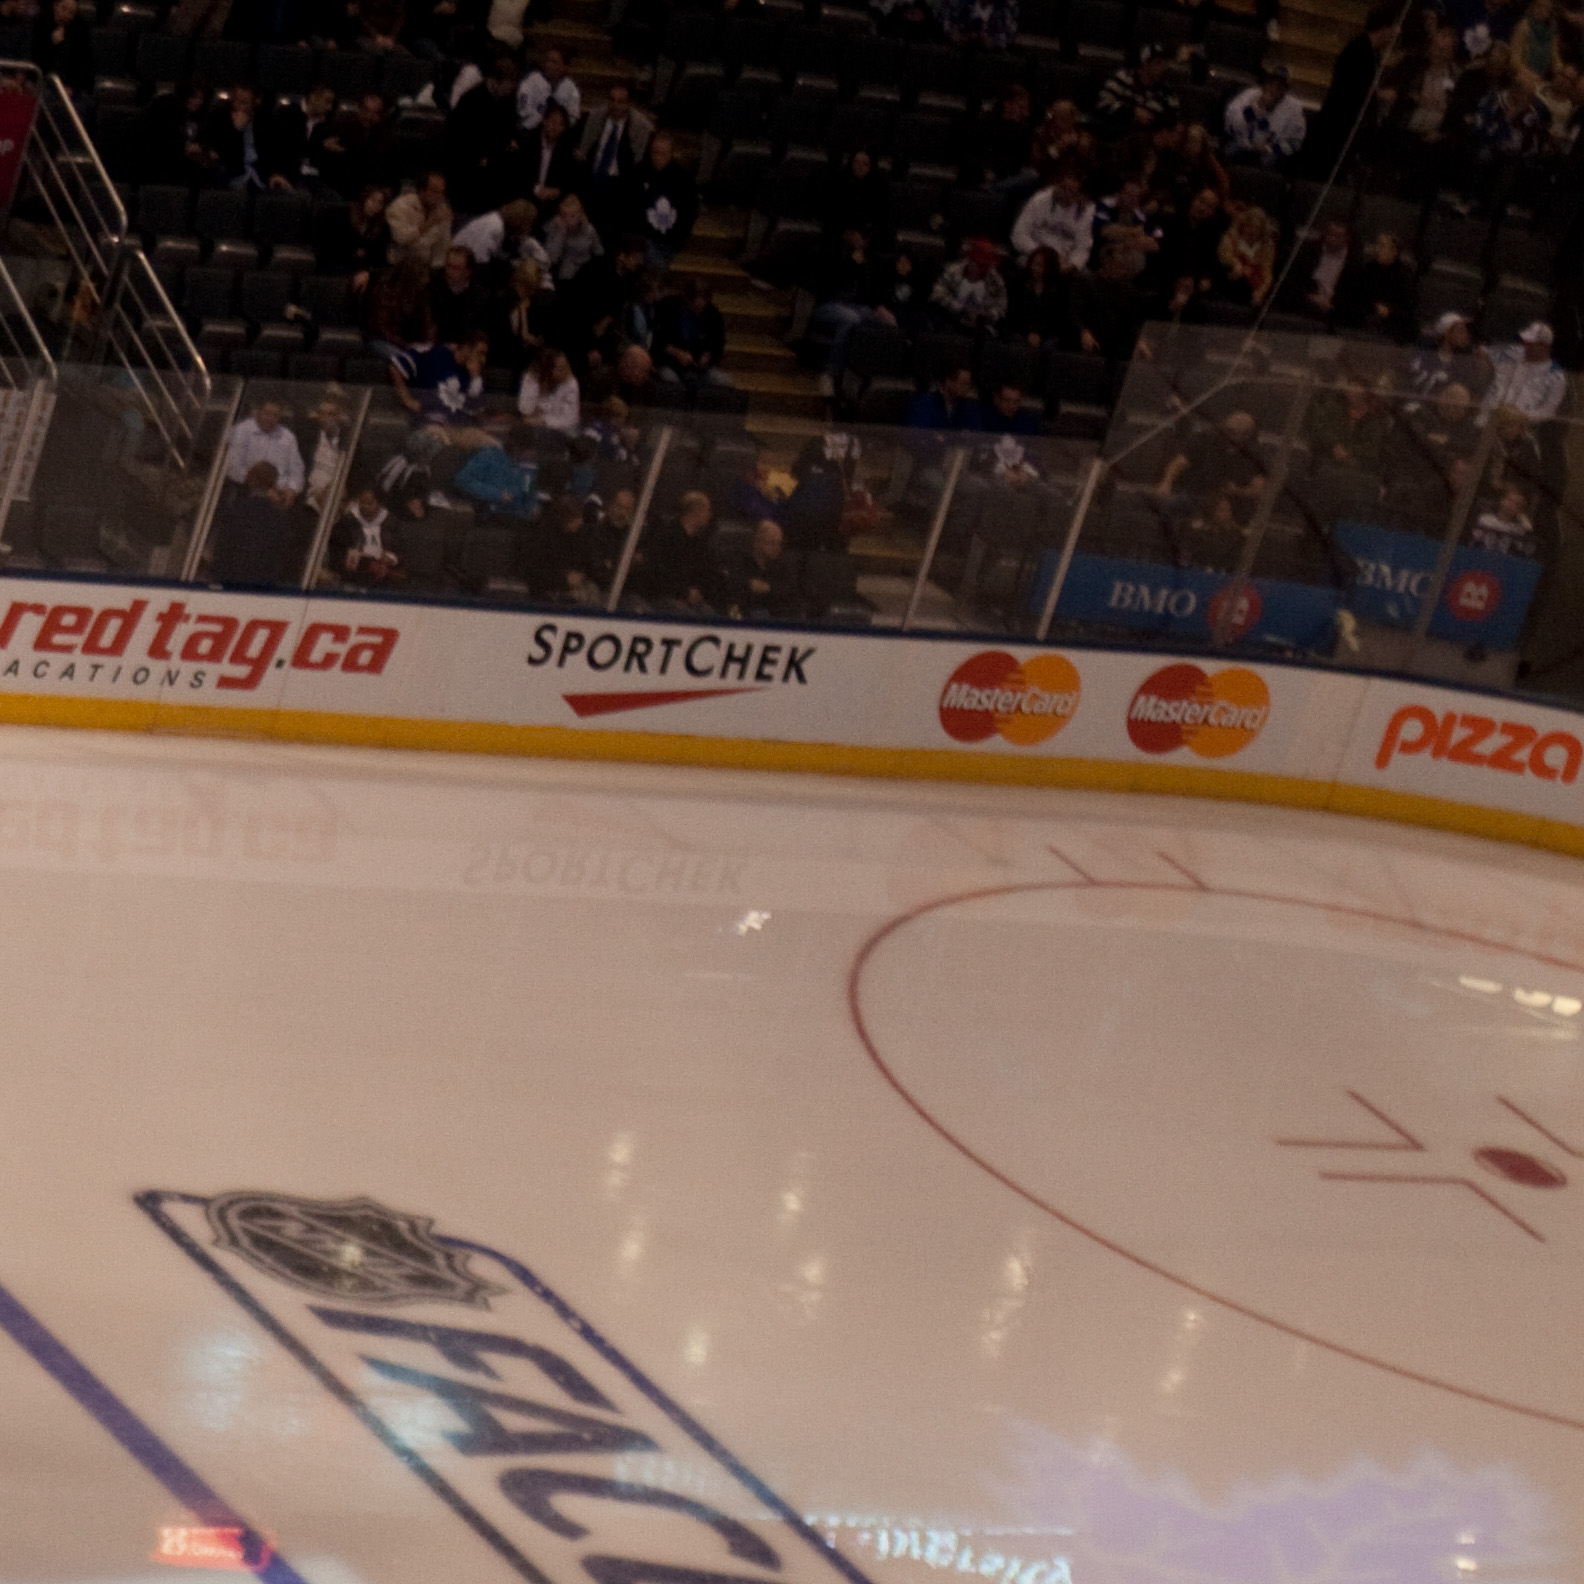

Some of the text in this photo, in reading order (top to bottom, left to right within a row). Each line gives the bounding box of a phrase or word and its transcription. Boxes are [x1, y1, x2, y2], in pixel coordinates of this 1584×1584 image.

[1108, 579, 1198, 619] BMO
[526, 623, 817, 687] SPORTCHEK
[940, 682, 1076, 718] MasterCard
[1130, 695, 1266, 730] MasterCard
[1373, 703, 1584, 786] pizza
